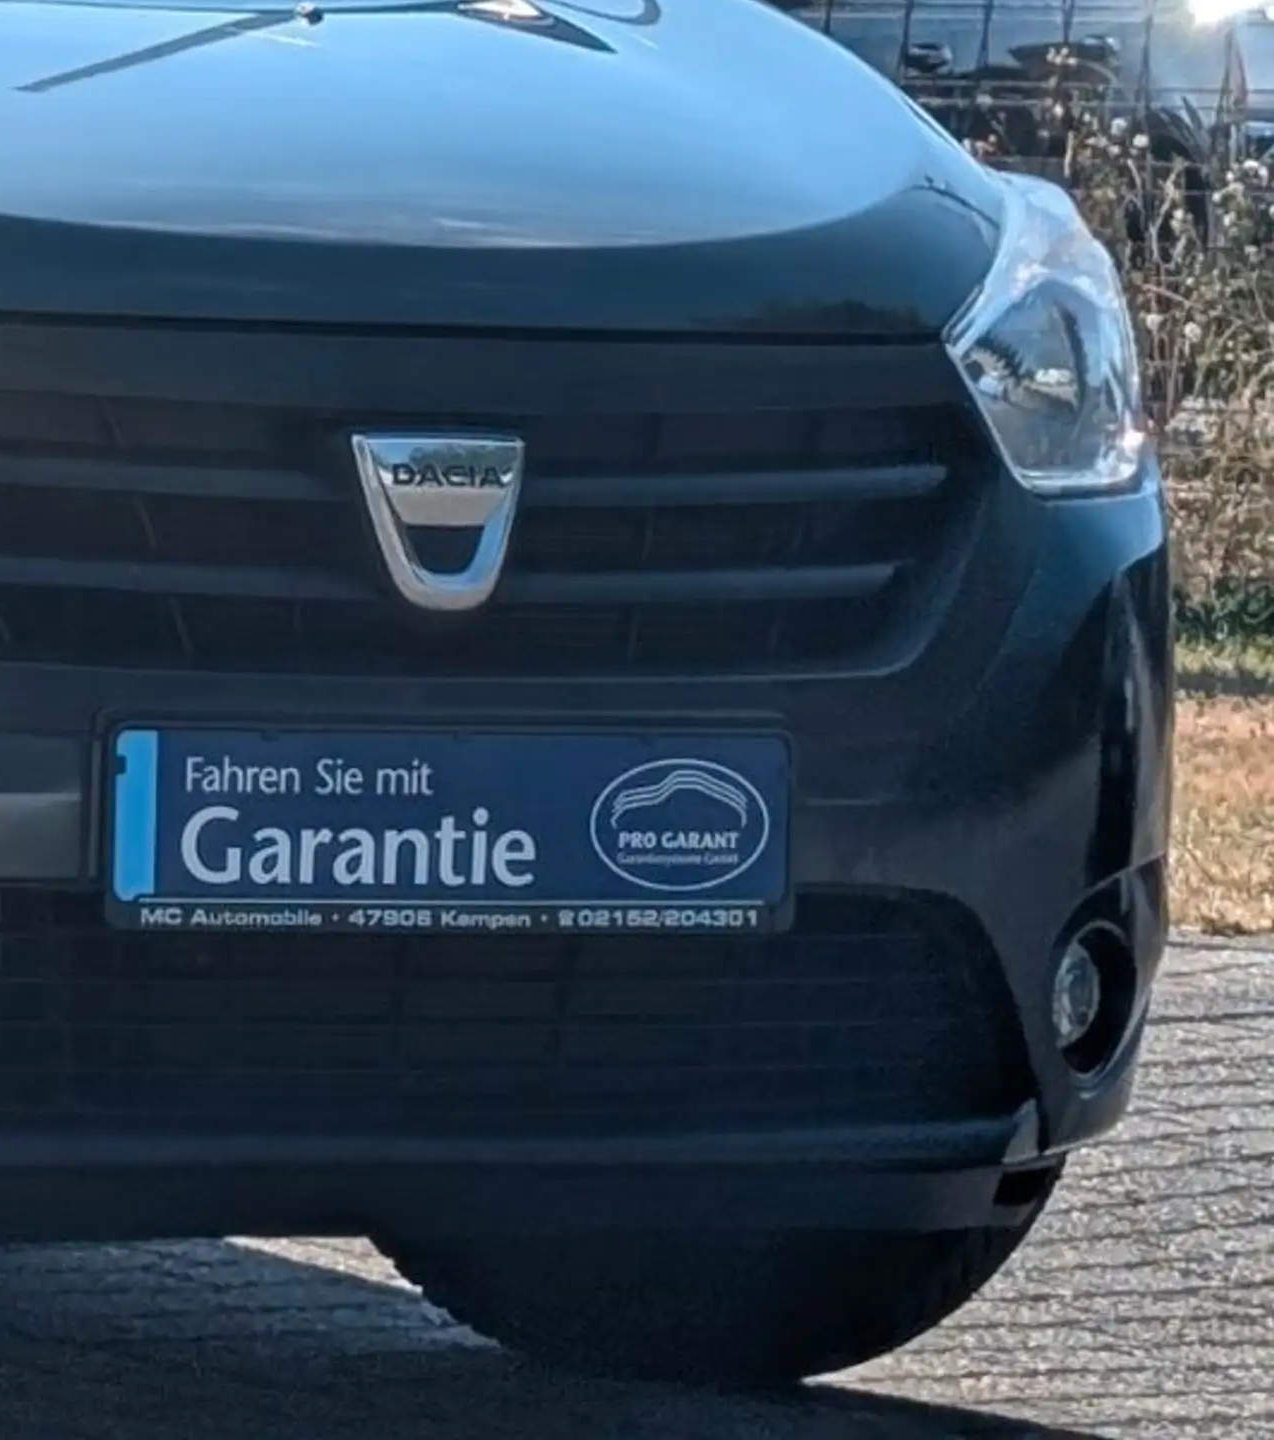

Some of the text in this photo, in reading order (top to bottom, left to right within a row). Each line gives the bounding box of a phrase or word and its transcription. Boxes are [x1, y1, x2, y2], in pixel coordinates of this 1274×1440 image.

[391, 462, 506, 490] DACIA
[185, 756, 435, 796] Fahren Sie mit
[180, 805, 538, 889] Garantie
[617, 831, 741, 850] PRO GARANT
[139, 907, 183, 927] MC
[189, 907, 323, 928] Automobile
[440, 908, 532, 931] Kempen
